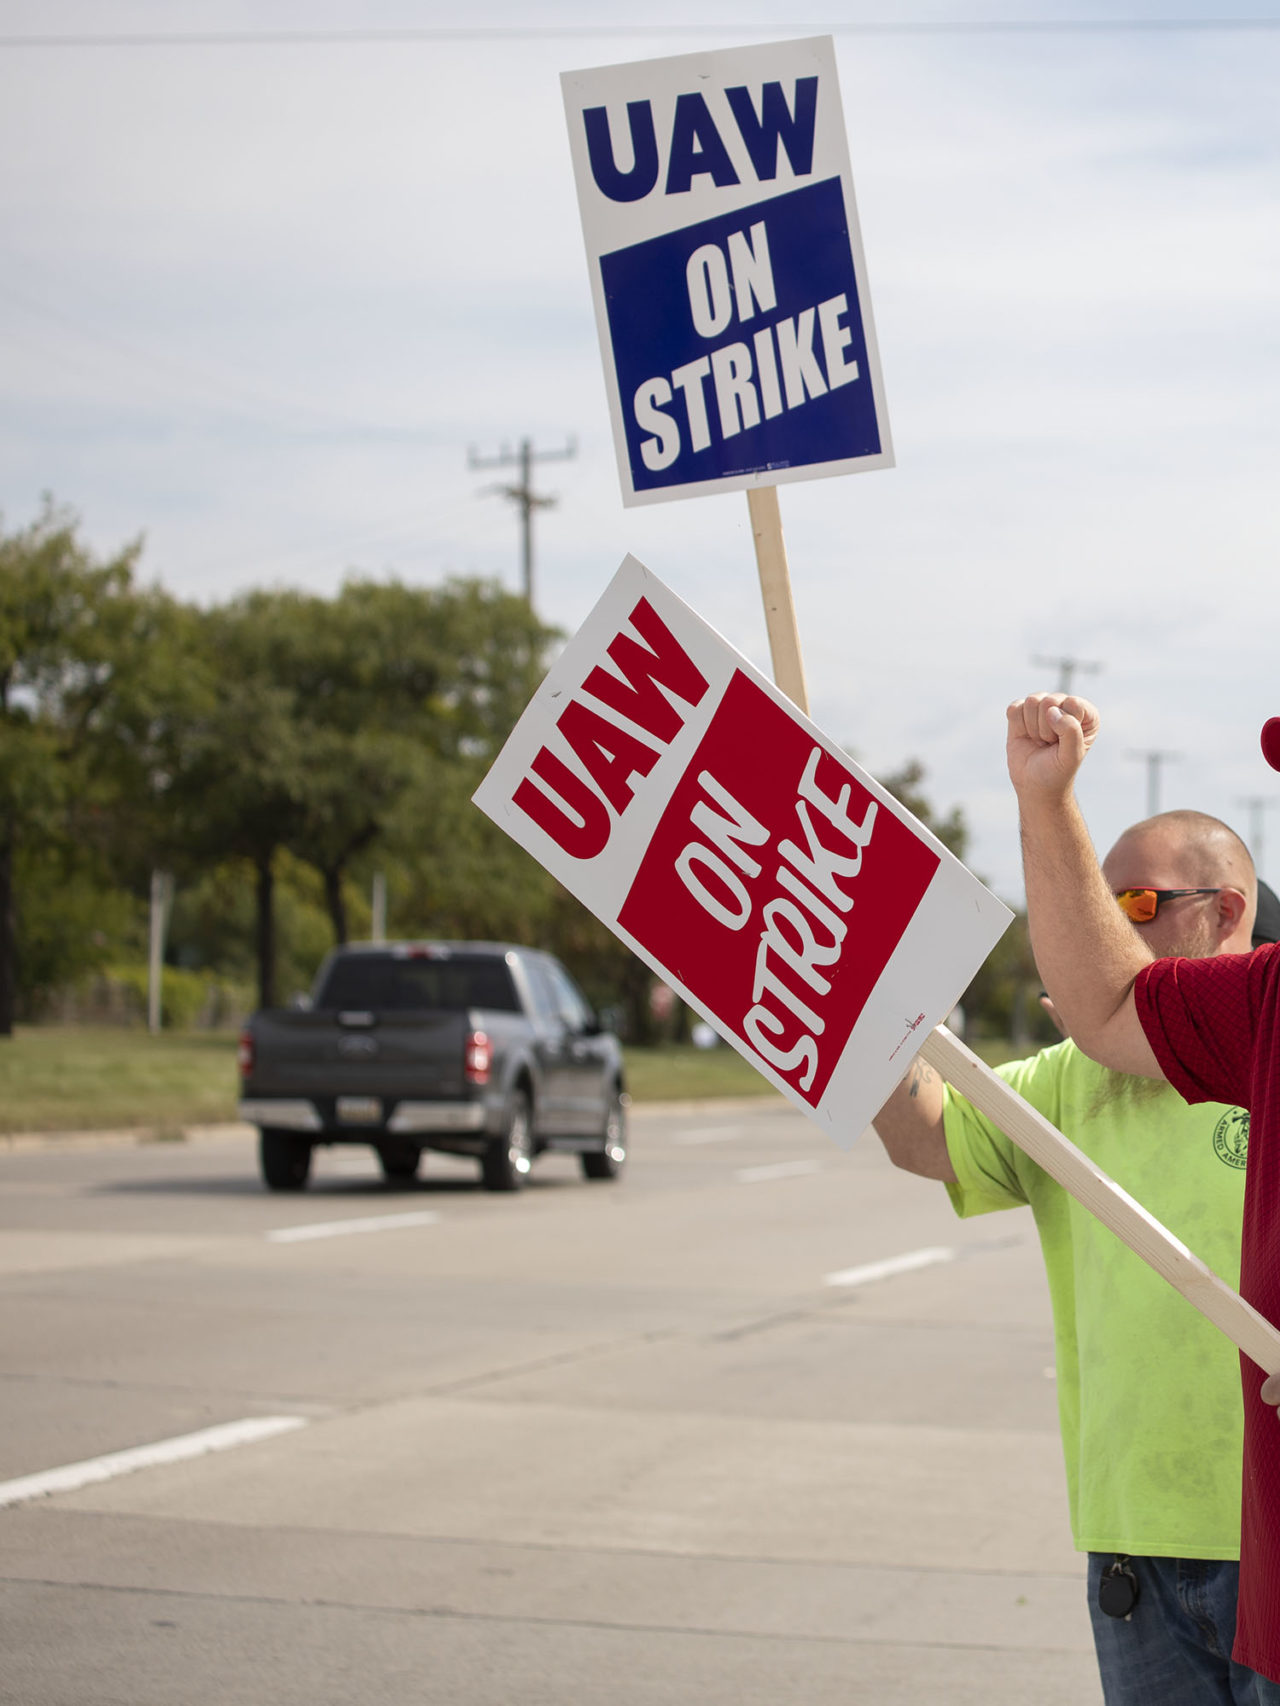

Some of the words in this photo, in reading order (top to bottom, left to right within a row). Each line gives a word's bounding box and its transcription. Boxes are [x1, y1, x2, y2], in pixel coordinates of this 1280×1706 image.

[582, 76, 819, 203] UAW
[686, 220, 777, 338] ON
[633, 293, 860, 472] STRIKE
[511, 595, 710, 859] UAW
[674, 769, 771, 931] ON
[742, 746, 879, 1092] STRIKE
